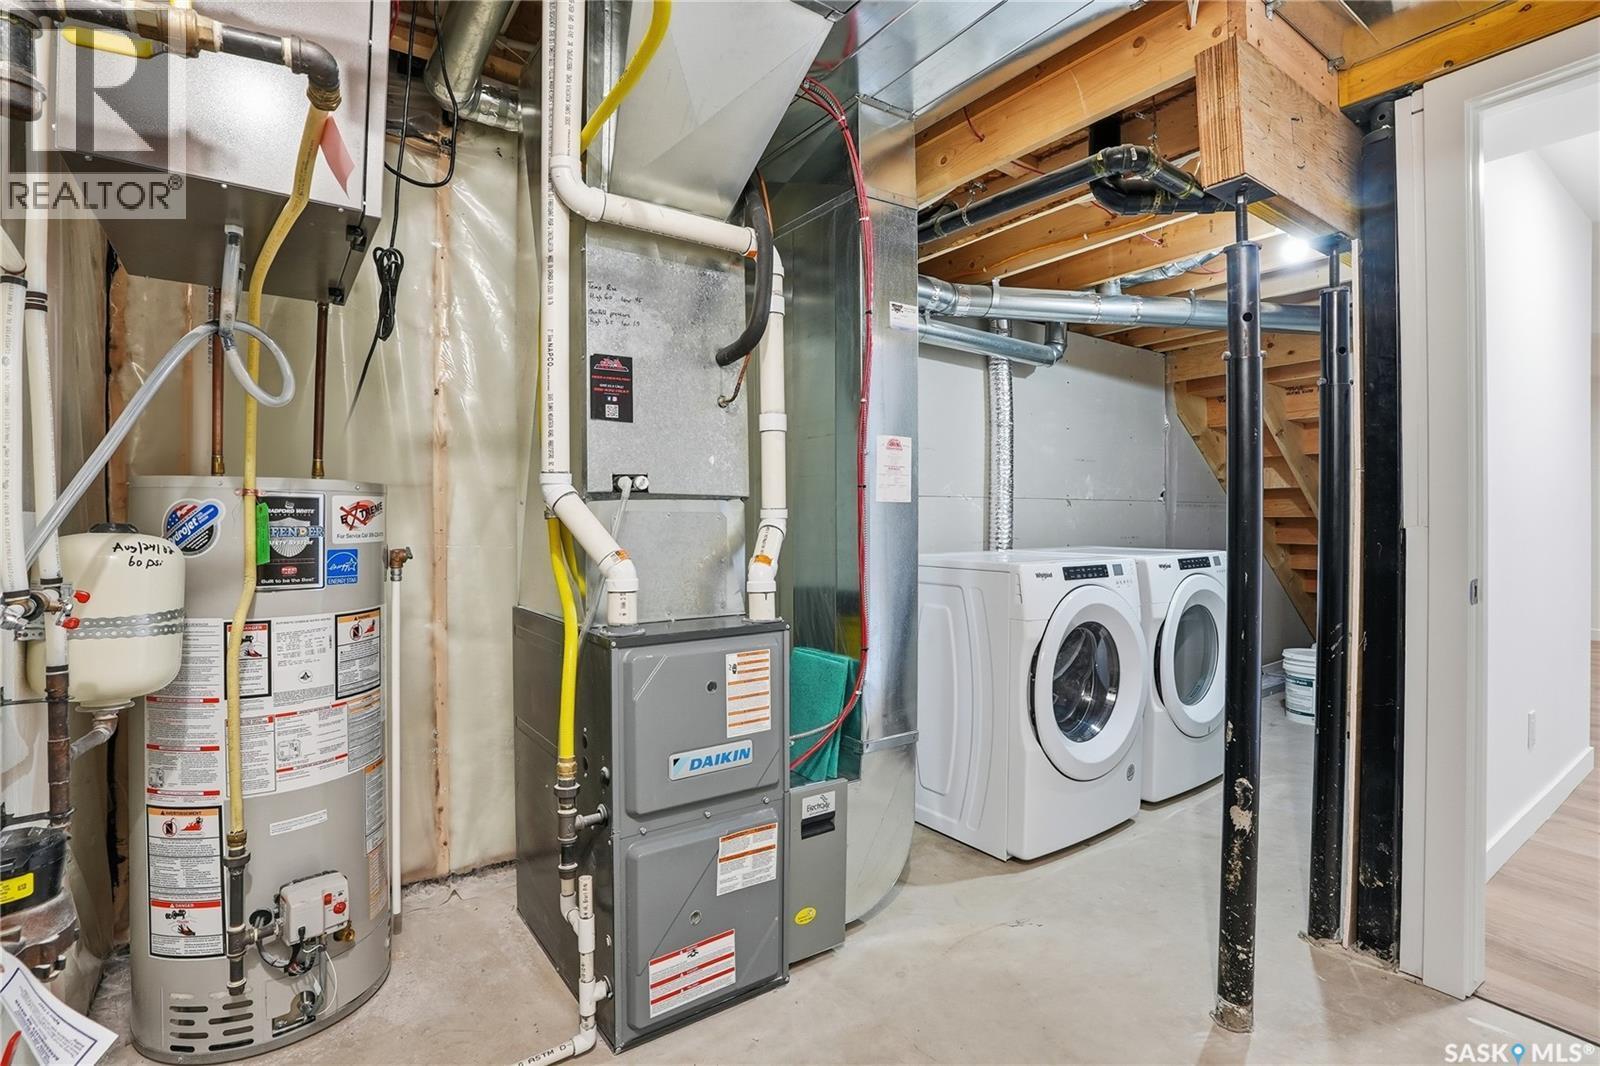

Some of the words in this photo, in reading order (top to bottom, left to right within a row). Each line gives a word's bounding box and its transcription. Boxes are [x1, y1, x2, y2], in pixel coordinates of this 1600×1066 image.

[340, 502, 383, 531] EXTREME
[271, 526, 325, 538] FENDER
[128, 555, 143, 567] 60
[145, 558, 164, 569] psi
[689, 748, 751, 771] DAIKIN
[528, 1049, 555, 1063] ASTM
